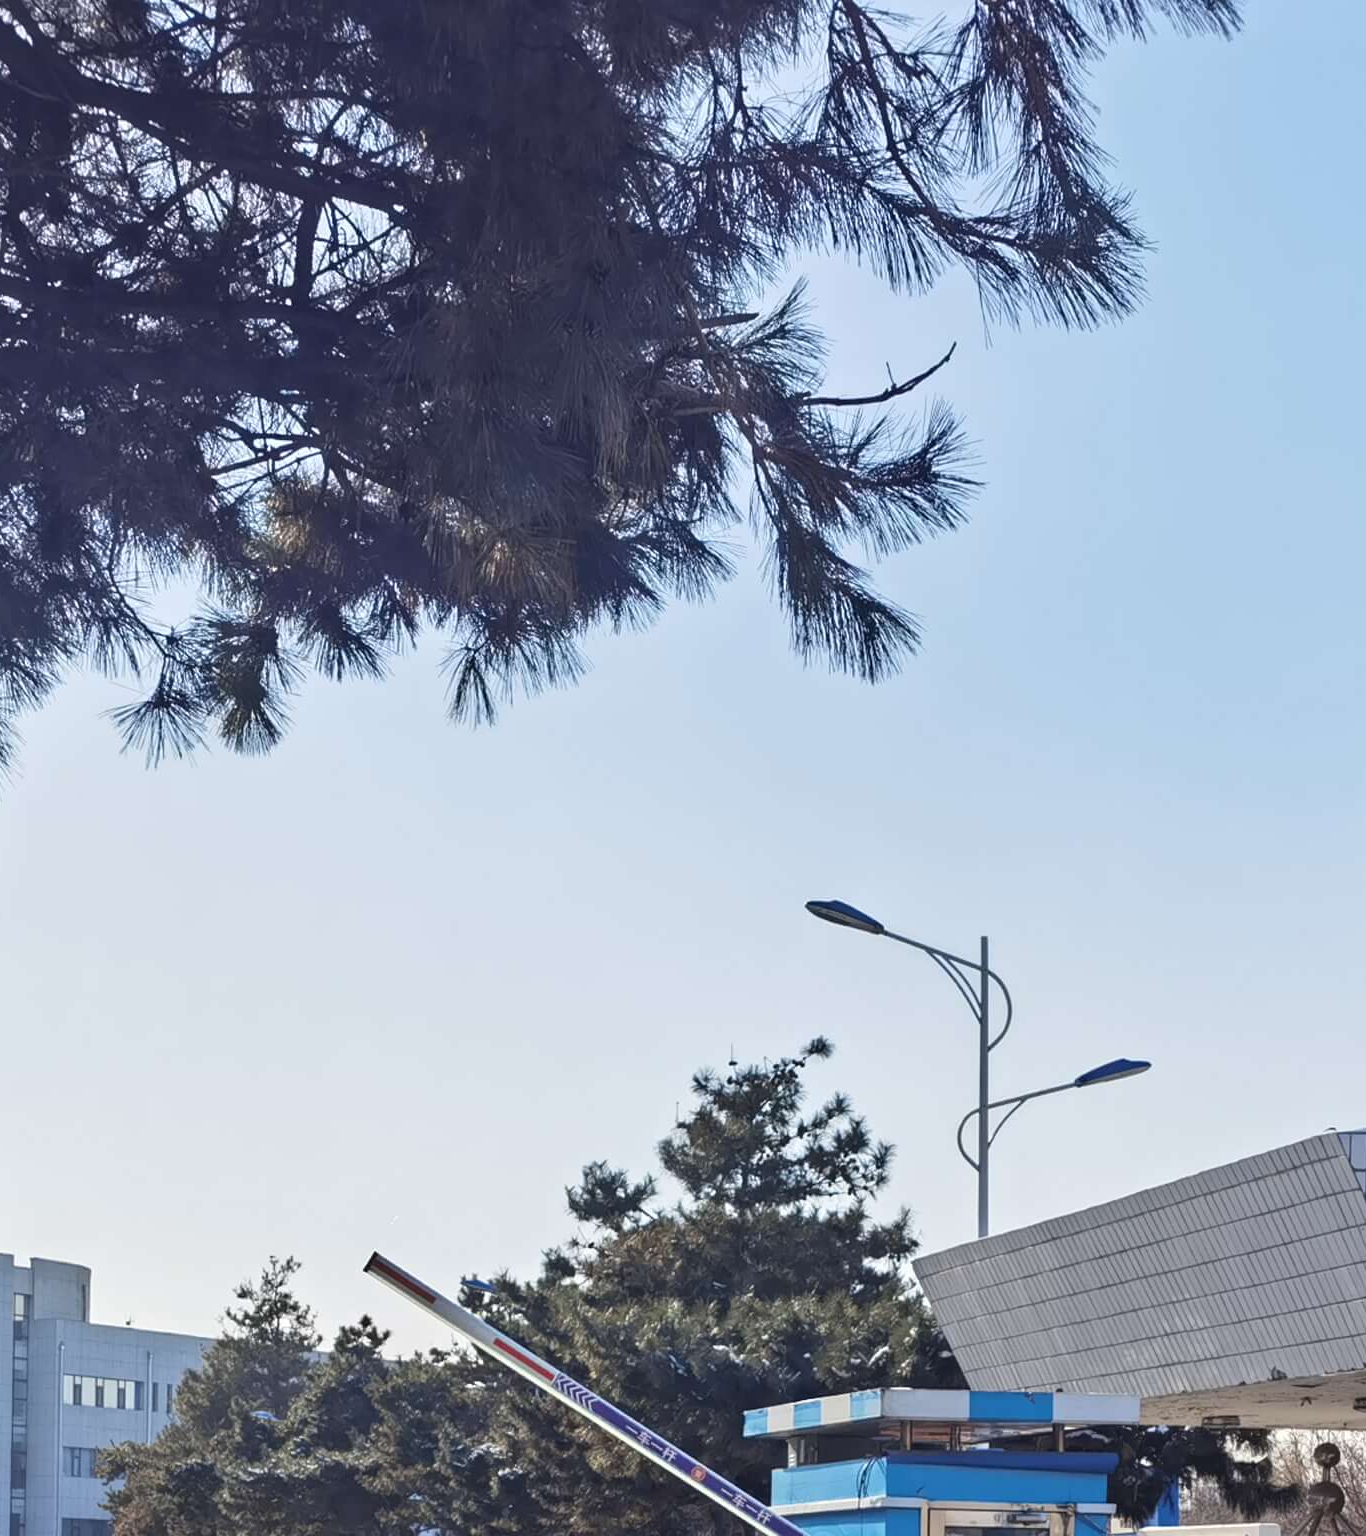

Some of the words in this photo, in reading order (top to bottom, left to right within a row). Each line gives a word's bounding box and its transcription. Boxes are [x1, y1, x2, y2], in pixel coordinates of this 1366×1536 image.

[625, 1424, 677, 1463] 一车一杆
[720, 1487, 772, 1525] 一车一杆
